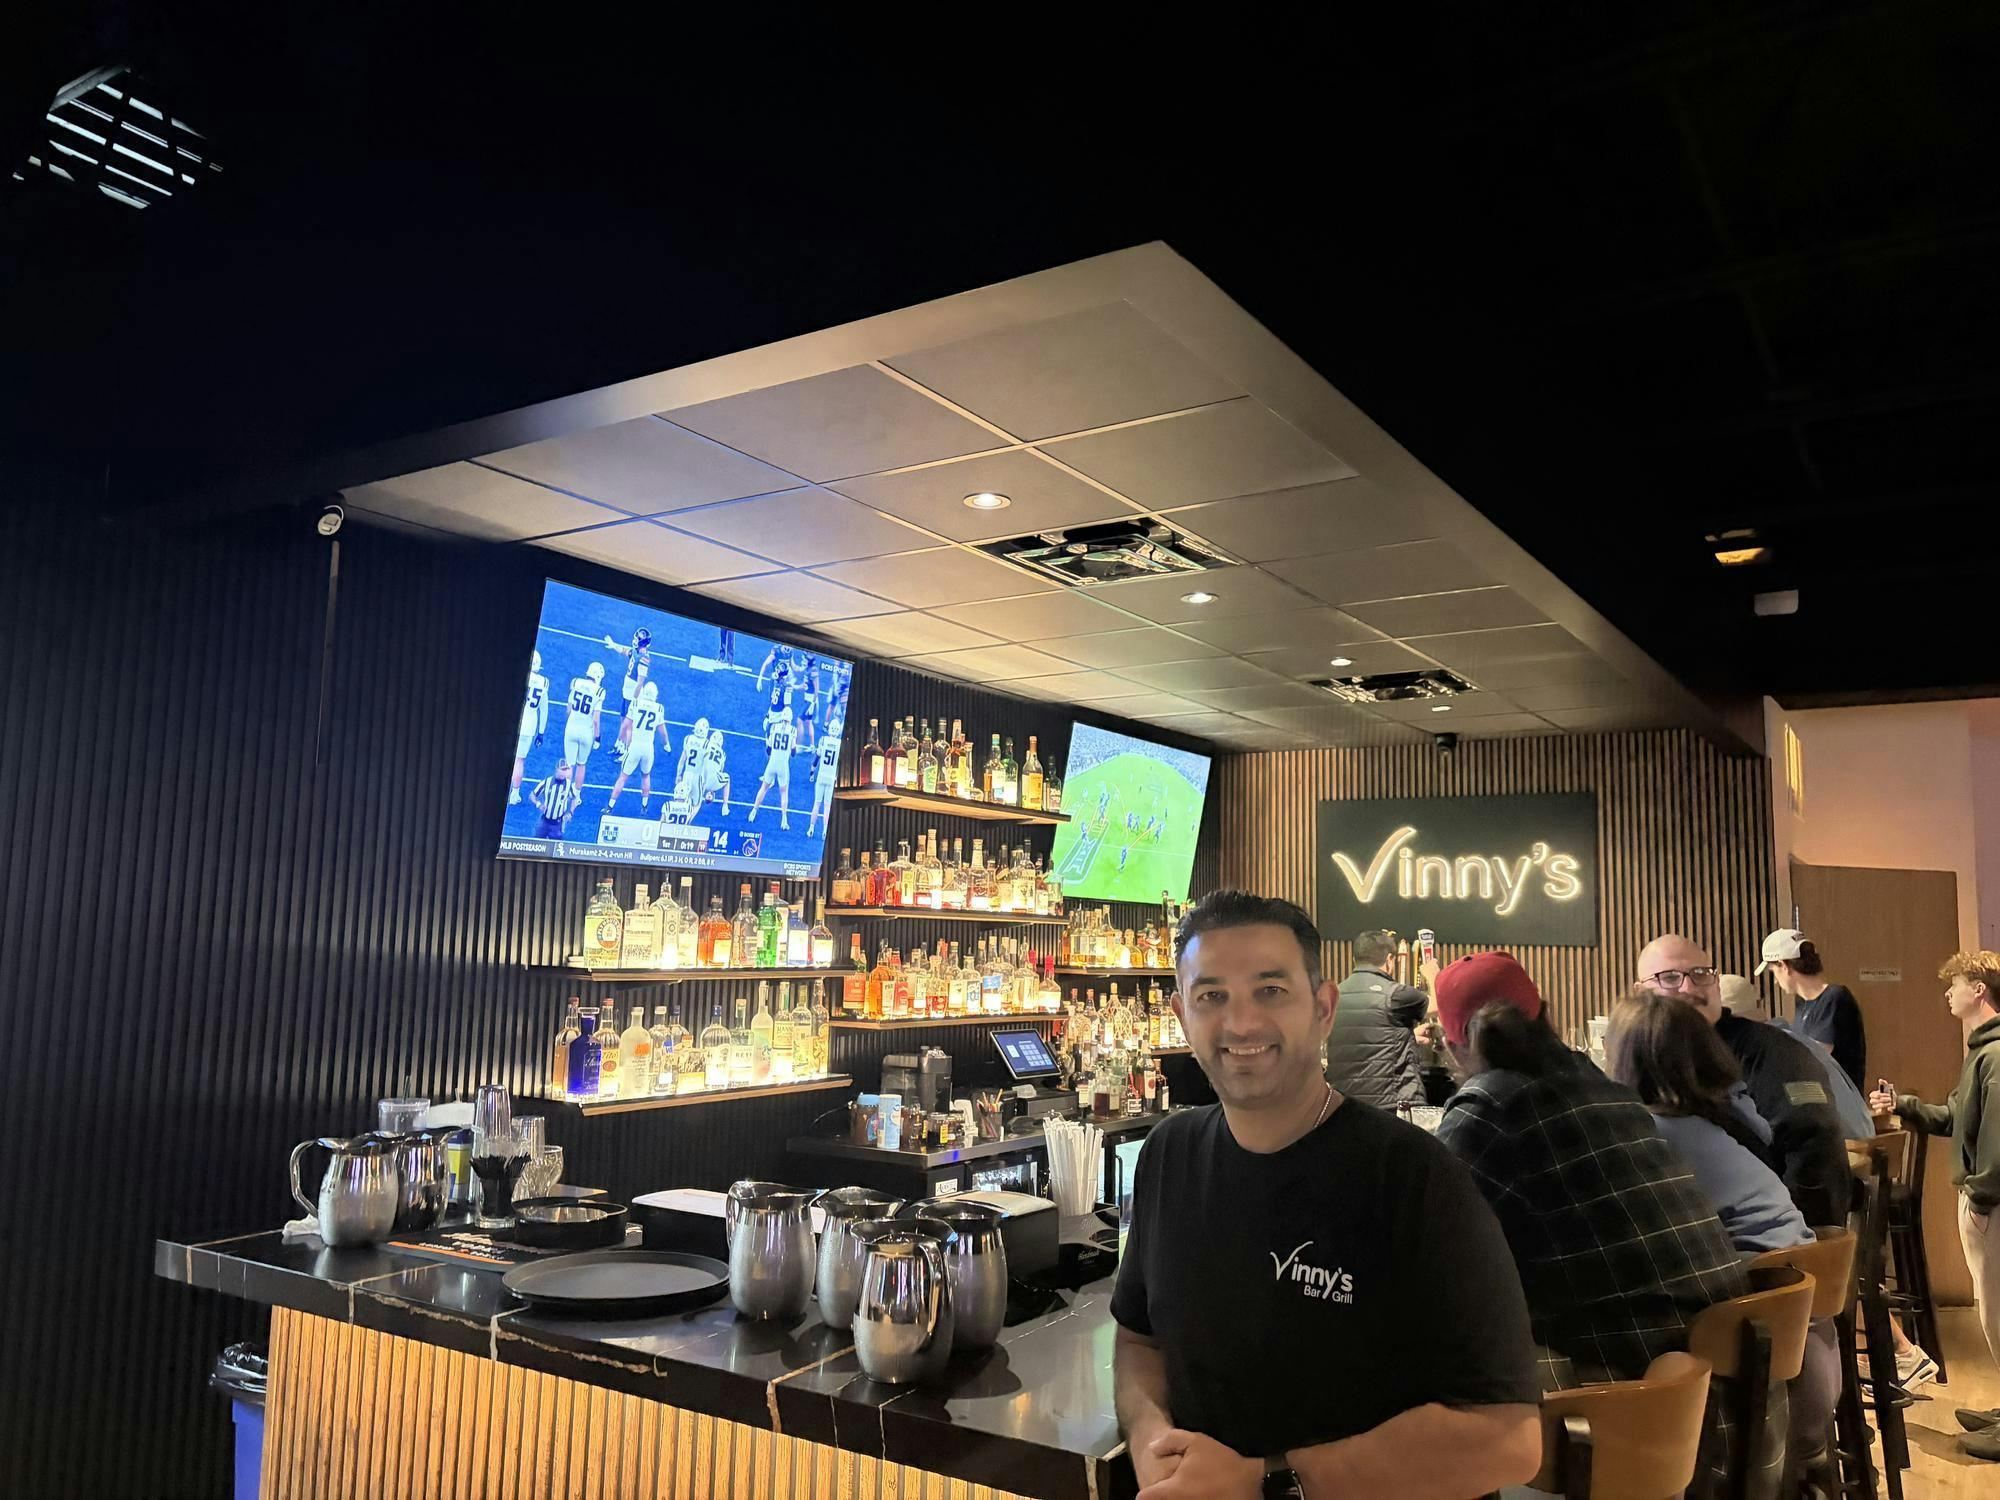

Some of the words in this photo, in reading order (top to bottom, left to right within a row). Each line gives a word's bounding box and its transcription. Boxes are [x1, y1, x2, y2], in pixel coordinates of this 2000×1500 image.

[527, 688, 542, 708] 5
[572, 690, 593, 715] 56
[636, 709, 657, 730] 72
[773, 733, 790, 751] 69
[688, 749, 698, 766] 2
[824, 749, 836, 766] 51
[642, 824, 653, 842] 0
[712, 830, 728, 848] 14
[512, 842, 546, 853] POSTSEASON
[609, 850, 624, 858] 2-run
[680, 841, 694, 850] 0:19
[1331, 825, 1582, 916] Vinny's
[1270, 1240, 1353, 1300] Vinny's
[1304, 1284, 1321, 1298] Bar
[1332, 1290, 1353, 1304] Grill
